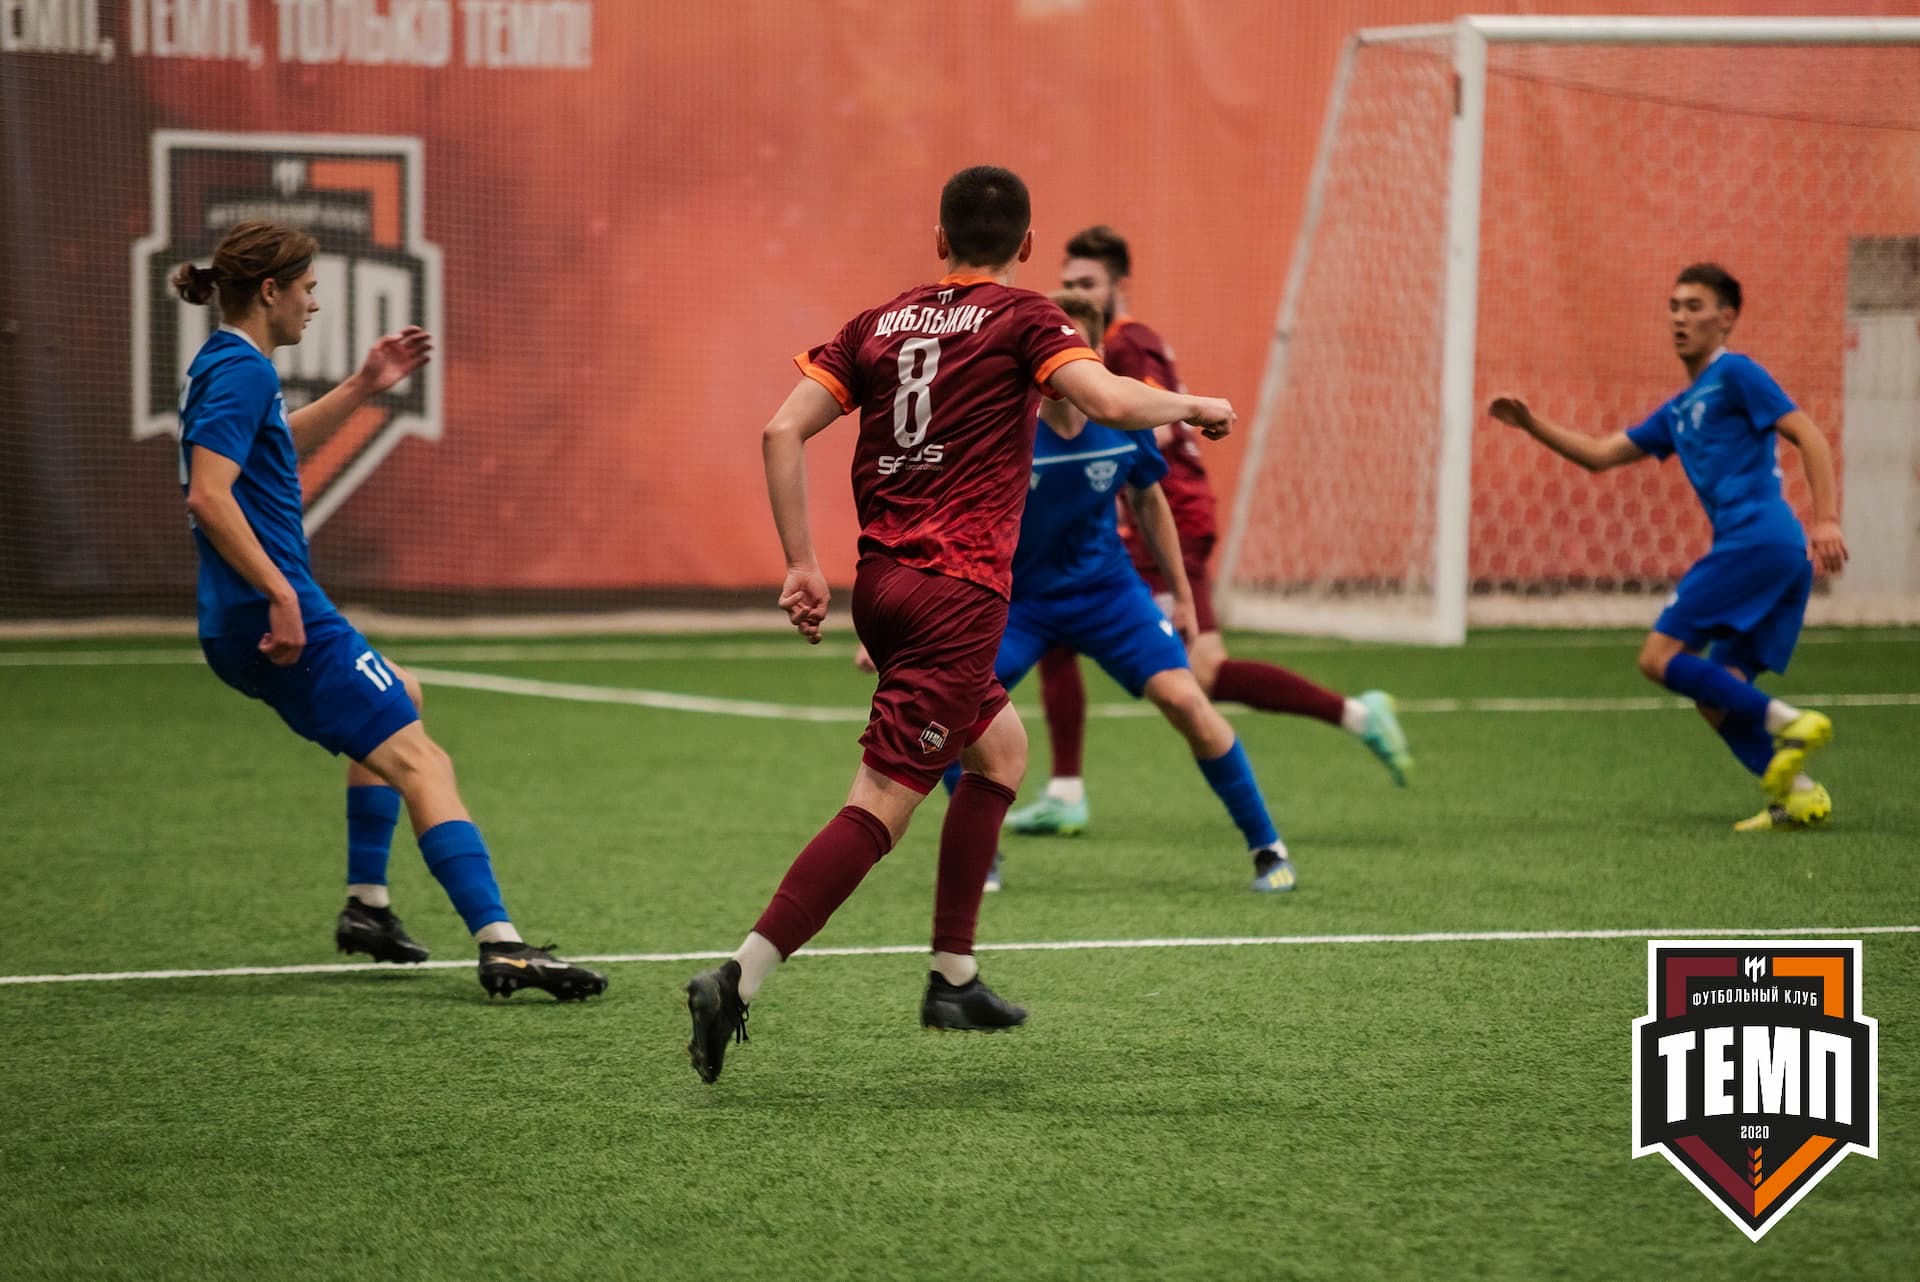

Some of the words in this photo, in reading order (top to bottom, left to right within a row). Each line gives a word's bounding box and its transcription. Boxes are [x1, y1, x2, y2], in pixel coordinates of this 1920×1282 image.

[273, 0, 450, 67] ТОЛЬКО
[893, 337, 941, 448] 8
[355, 650, 393, 692] 17
